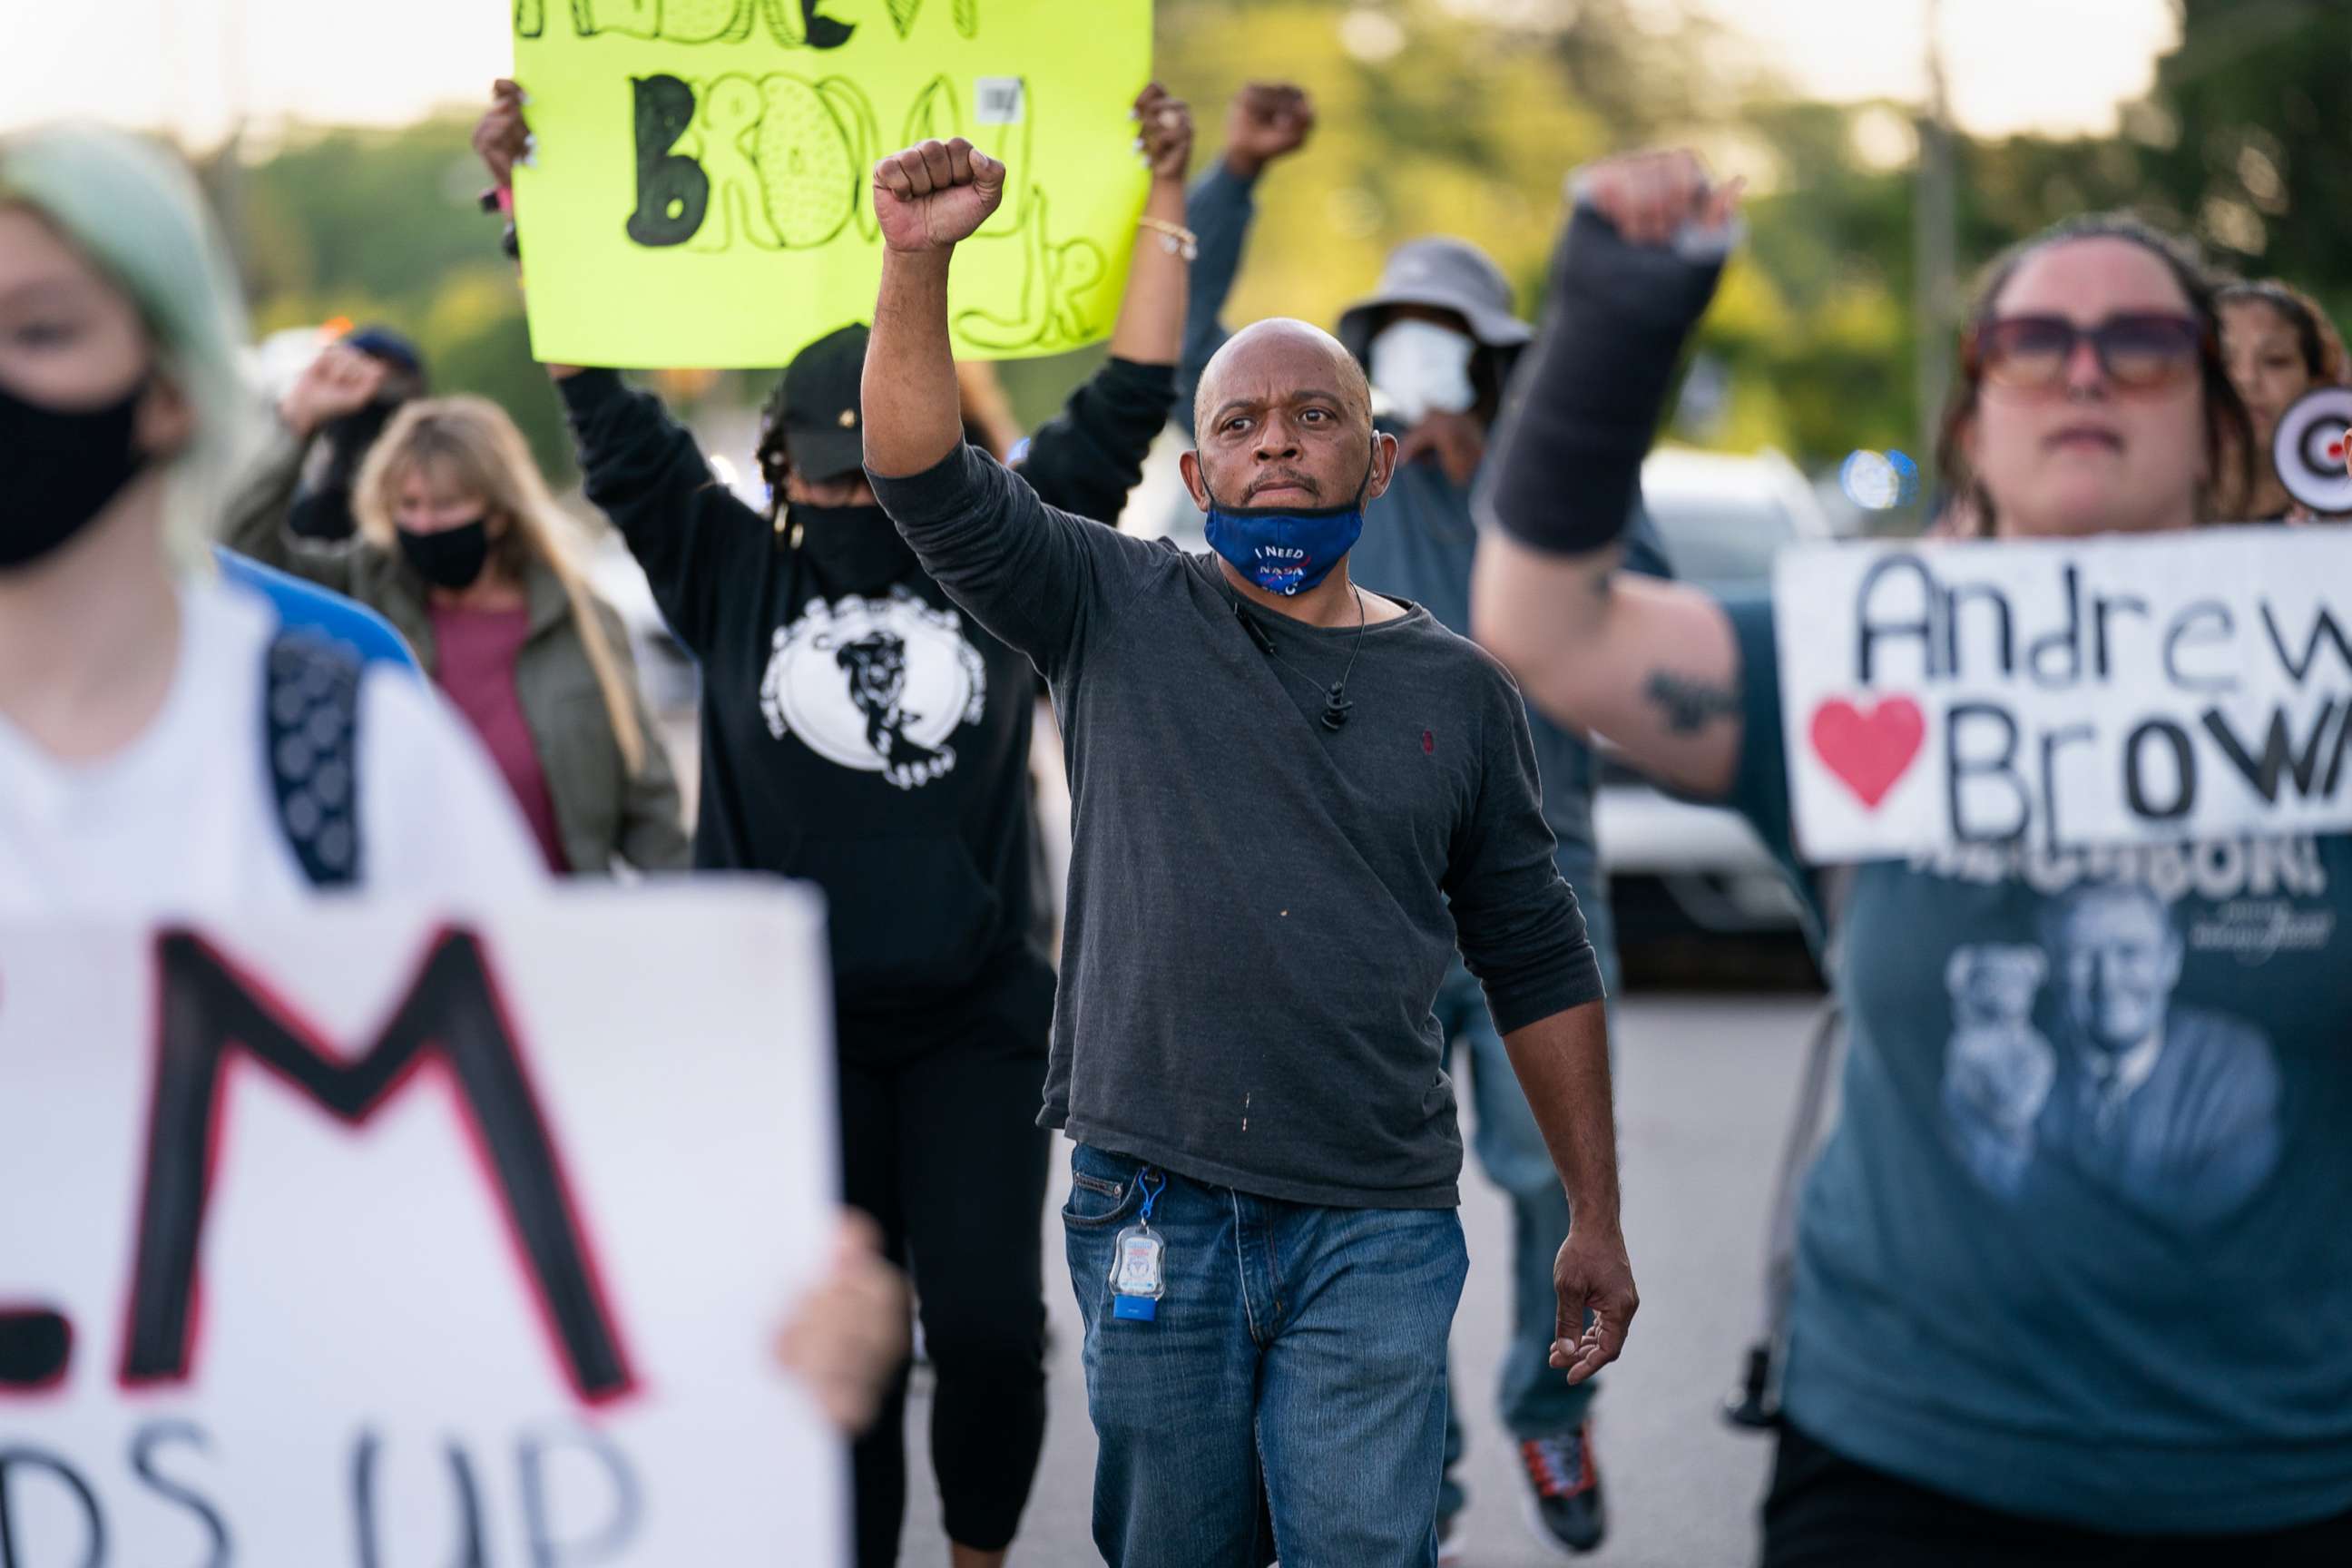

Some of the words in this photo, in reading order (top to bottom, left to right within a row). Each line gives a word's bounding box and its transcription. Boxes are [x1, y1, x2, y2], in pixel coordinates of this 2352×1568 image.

[626, 71, 1034, 251] BRO
[1255, 548, 1262, 559] I
[1265, 545, 1304, 559] NEED
[1259, 566, 1304, 577] NASA
[1856, 554, 2352, 691] Andrew
[1947, 697, 2352, 855] Brow
[349, 1426, 646, 1568] UP
